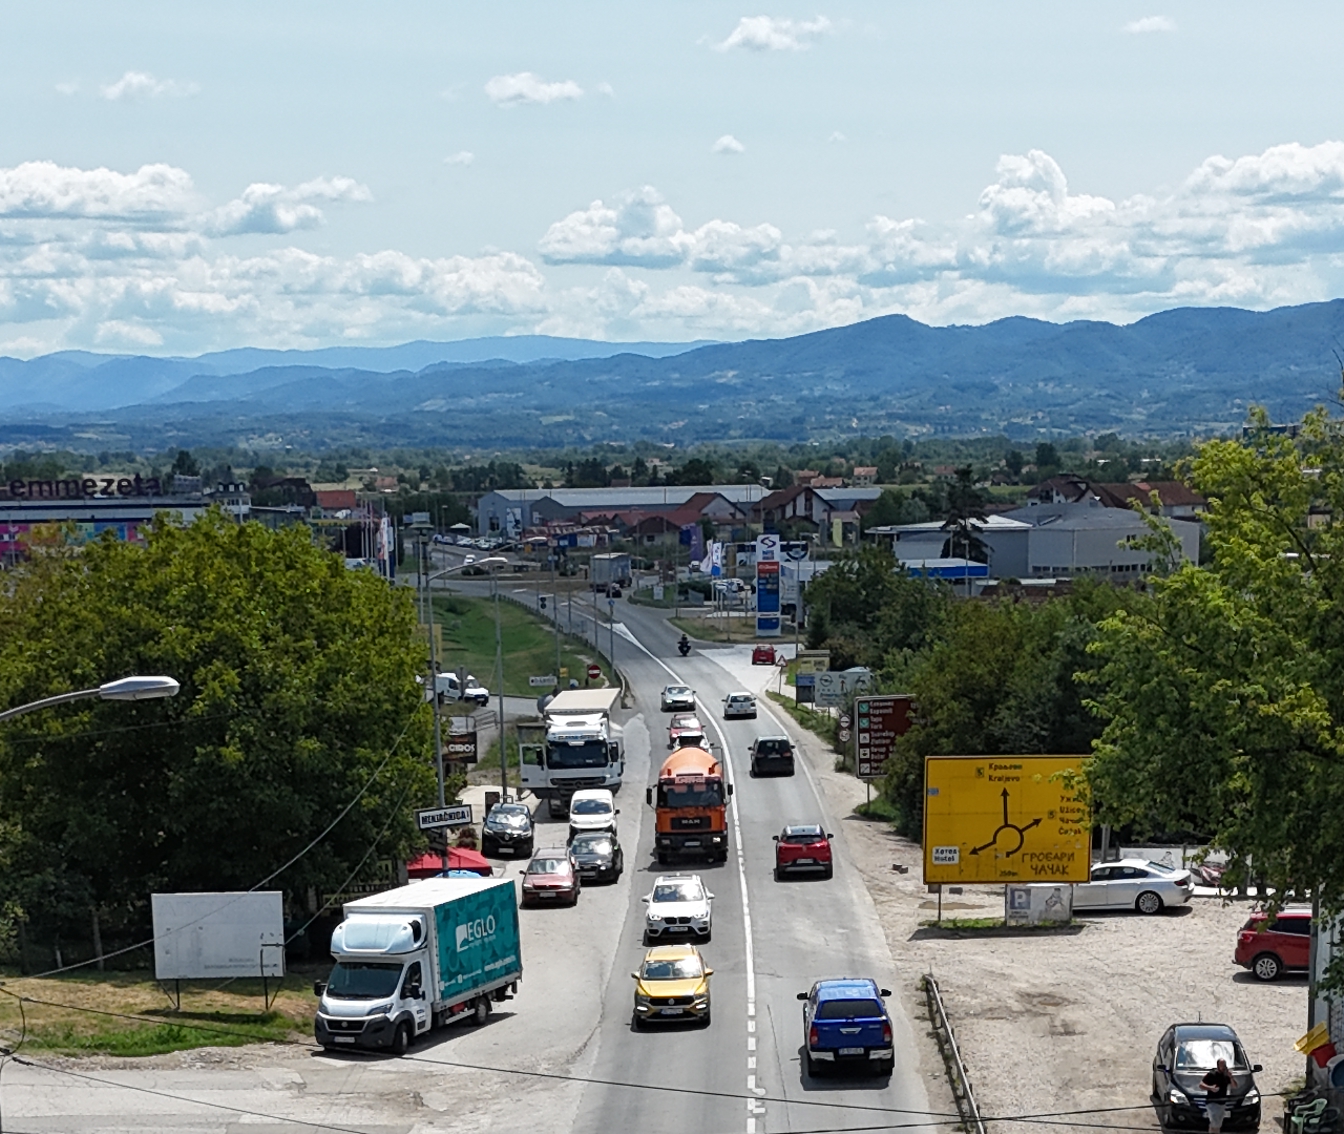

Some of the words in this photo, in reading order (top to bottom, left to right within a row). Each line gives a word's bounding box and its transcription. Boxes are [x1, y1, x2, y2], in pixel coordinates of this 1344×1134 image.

[9, 473, 162, 497] emmezeta
[988, 775, 1020, 783] Kraljevo
[1021, 852, 1075, 863] ГРОБАРИ
[1030, 864, 1070, 876] ЧАЧАК
[467, 915, 496, 941] EGLO
